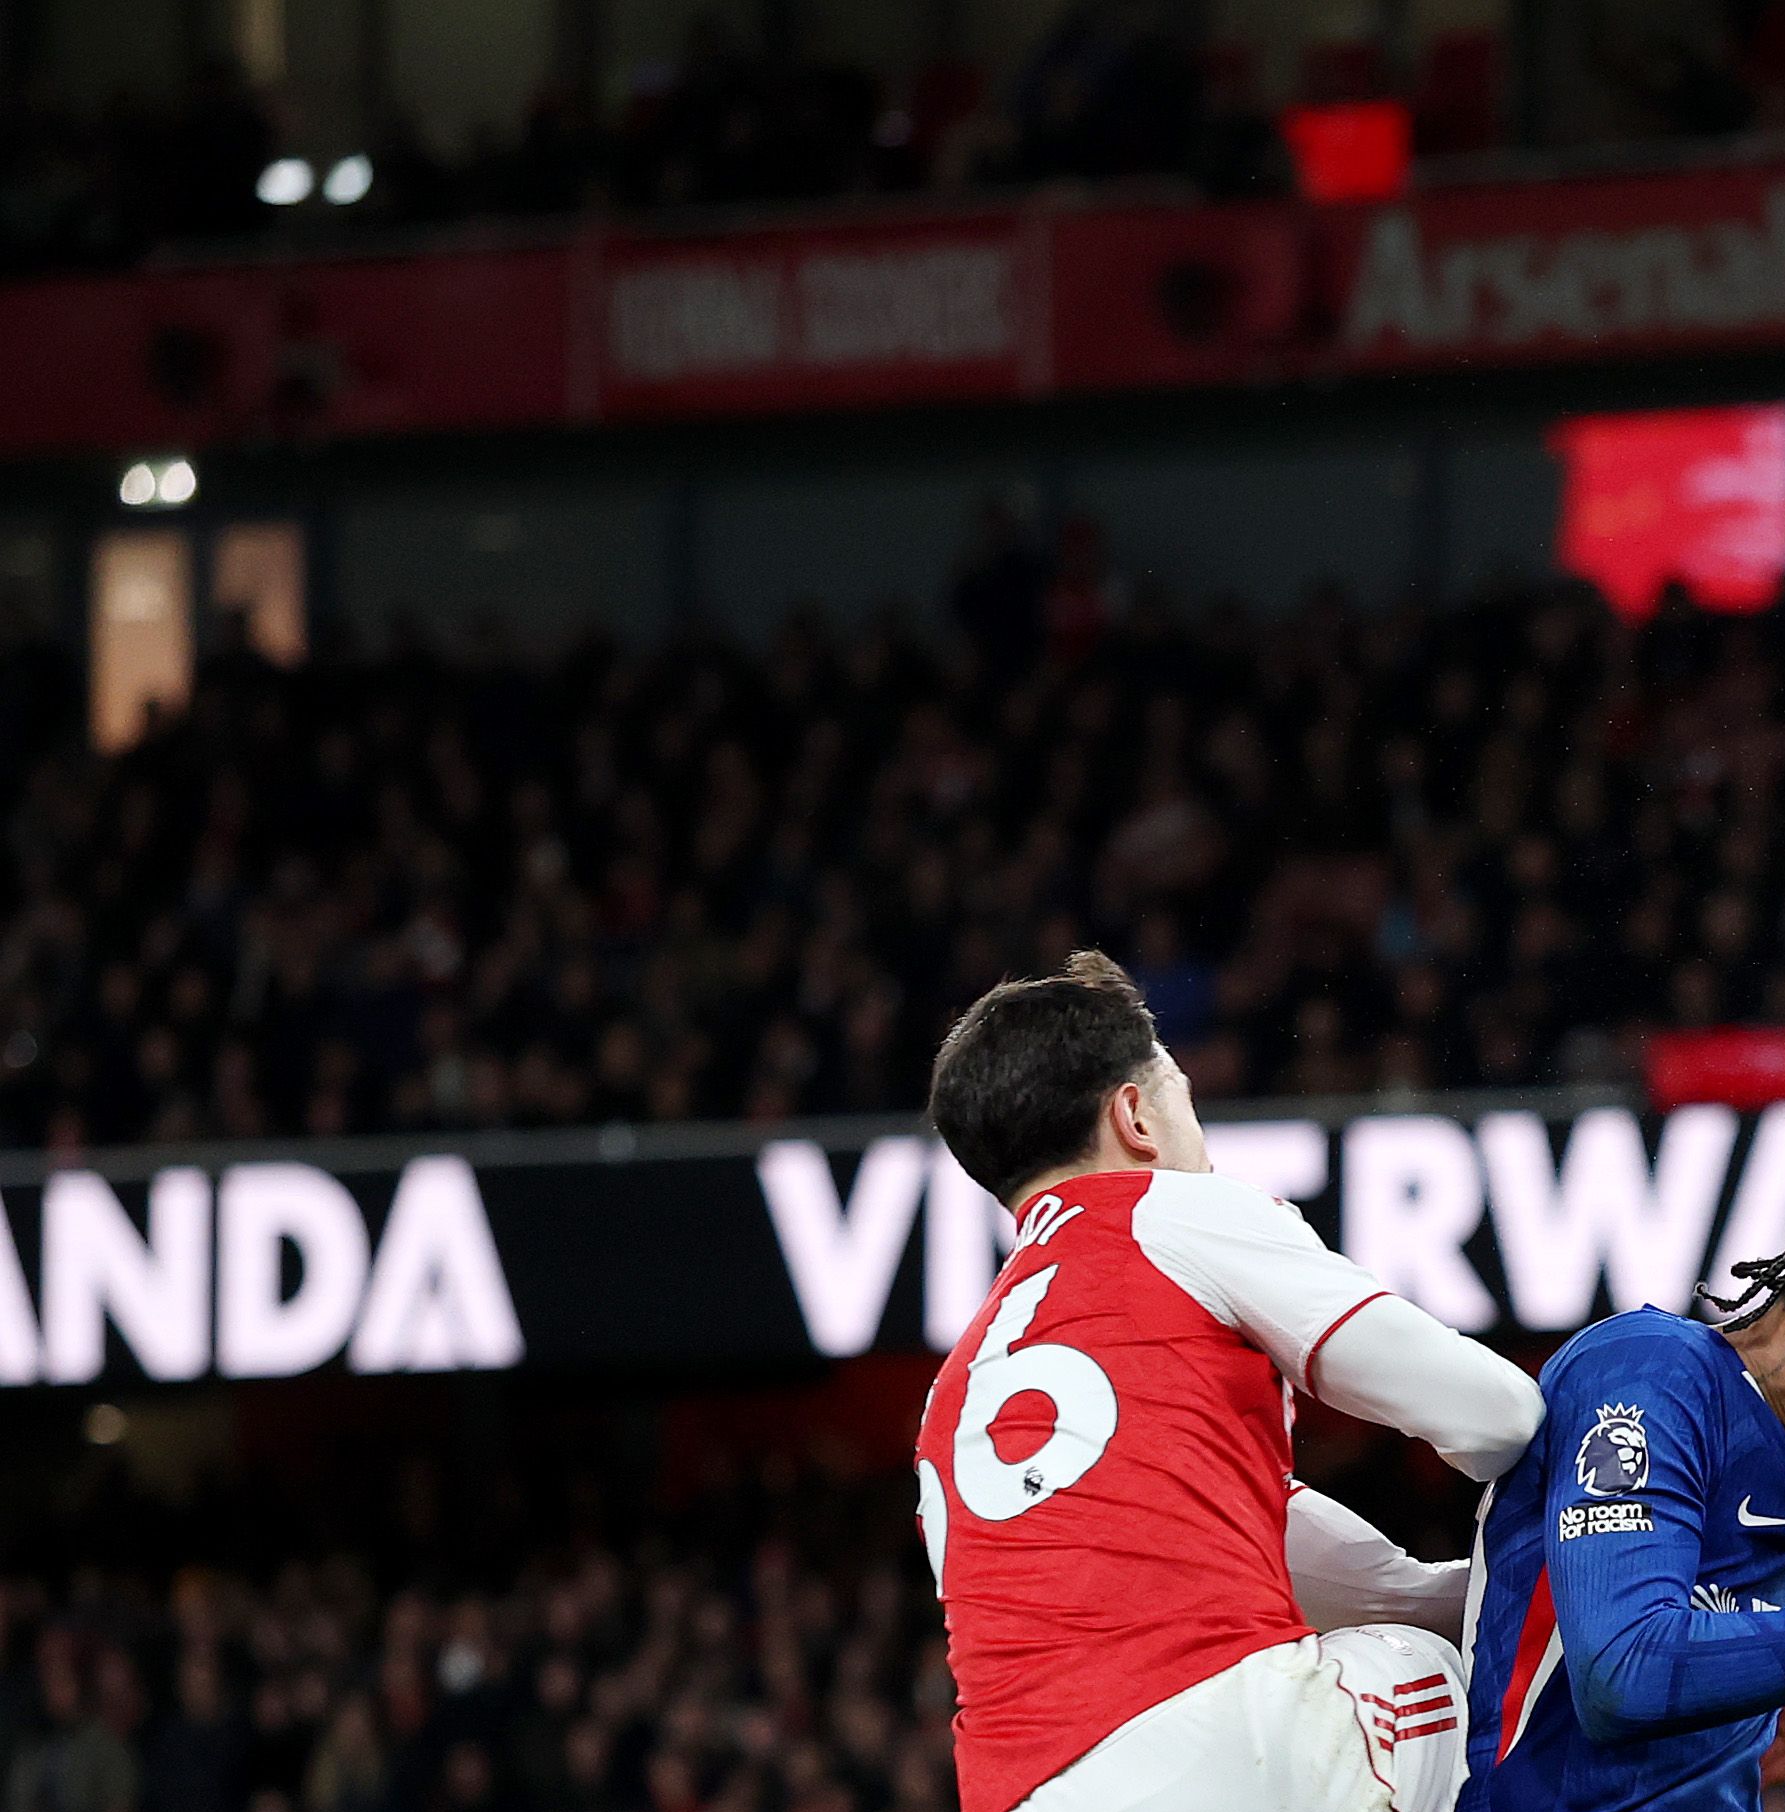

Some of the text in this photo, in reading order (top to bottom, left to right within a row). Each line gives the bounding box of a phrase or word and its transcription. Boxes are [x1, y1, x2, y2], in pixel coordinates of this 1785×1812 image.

[0, 1153, 524, 1386] NDA
[1560, 1503, 1643, 1527] No room
[1560, 1518, 1654, 1543] for racism
